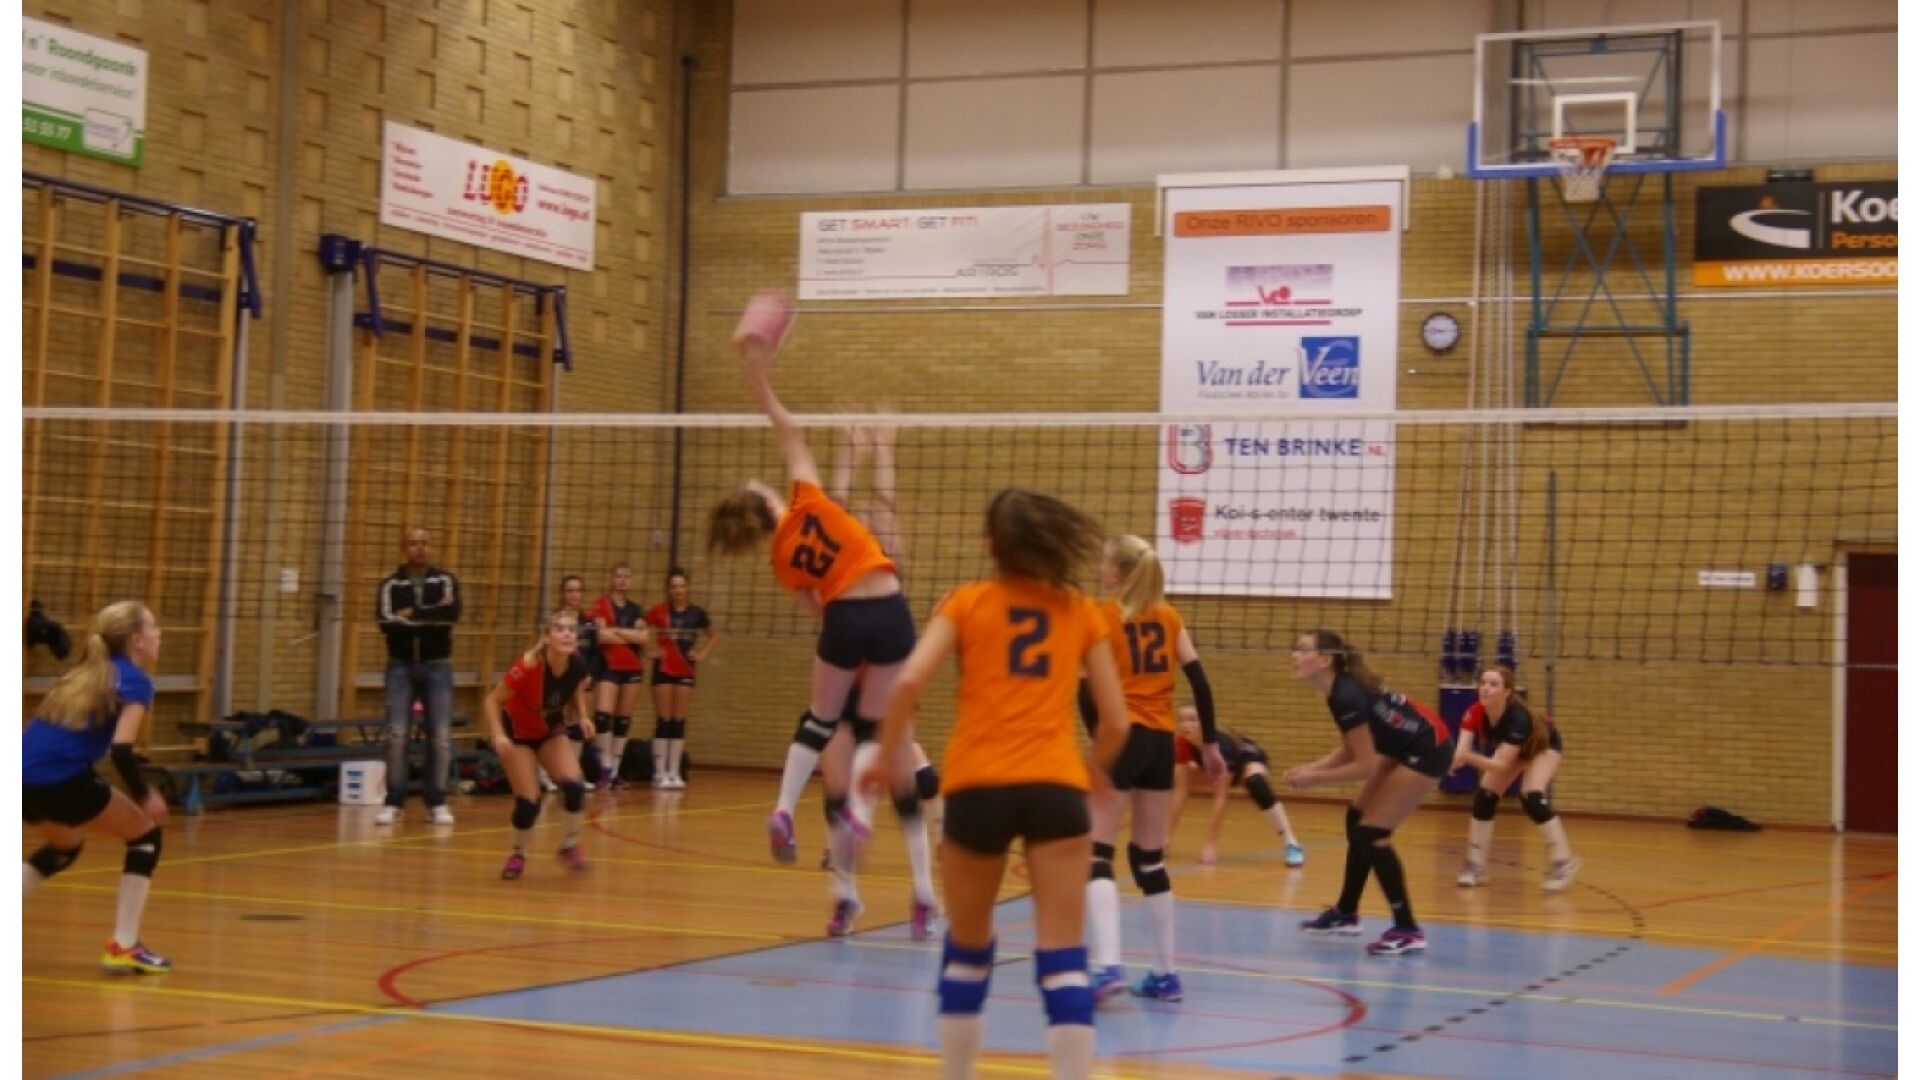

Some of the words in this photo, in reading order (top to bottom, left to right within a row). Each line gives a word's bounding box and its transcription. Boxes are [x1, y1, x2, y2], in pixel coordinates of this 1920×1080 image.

[817, 219, 848, 232] GET
[917, 216, 948, 229] GET
[1186, 216, 1230, 230] Onze
[1236, 214, 1281, 228] RIVO
[1287, 212, 1377, 229] sponsoren
[1196, 359, 1243, 387] Van
[1247, 359, 1292, 387] der
[1296, 346, 1360, 387] Veen
[1224, 438, 1270, 456] TEN
[1276, 438, 1363, 456] BRINKE
[790, 513, 842, 579] 27
[1008, 607, 1050, 678] 2
[1123, 621, 1170, 675] 12
